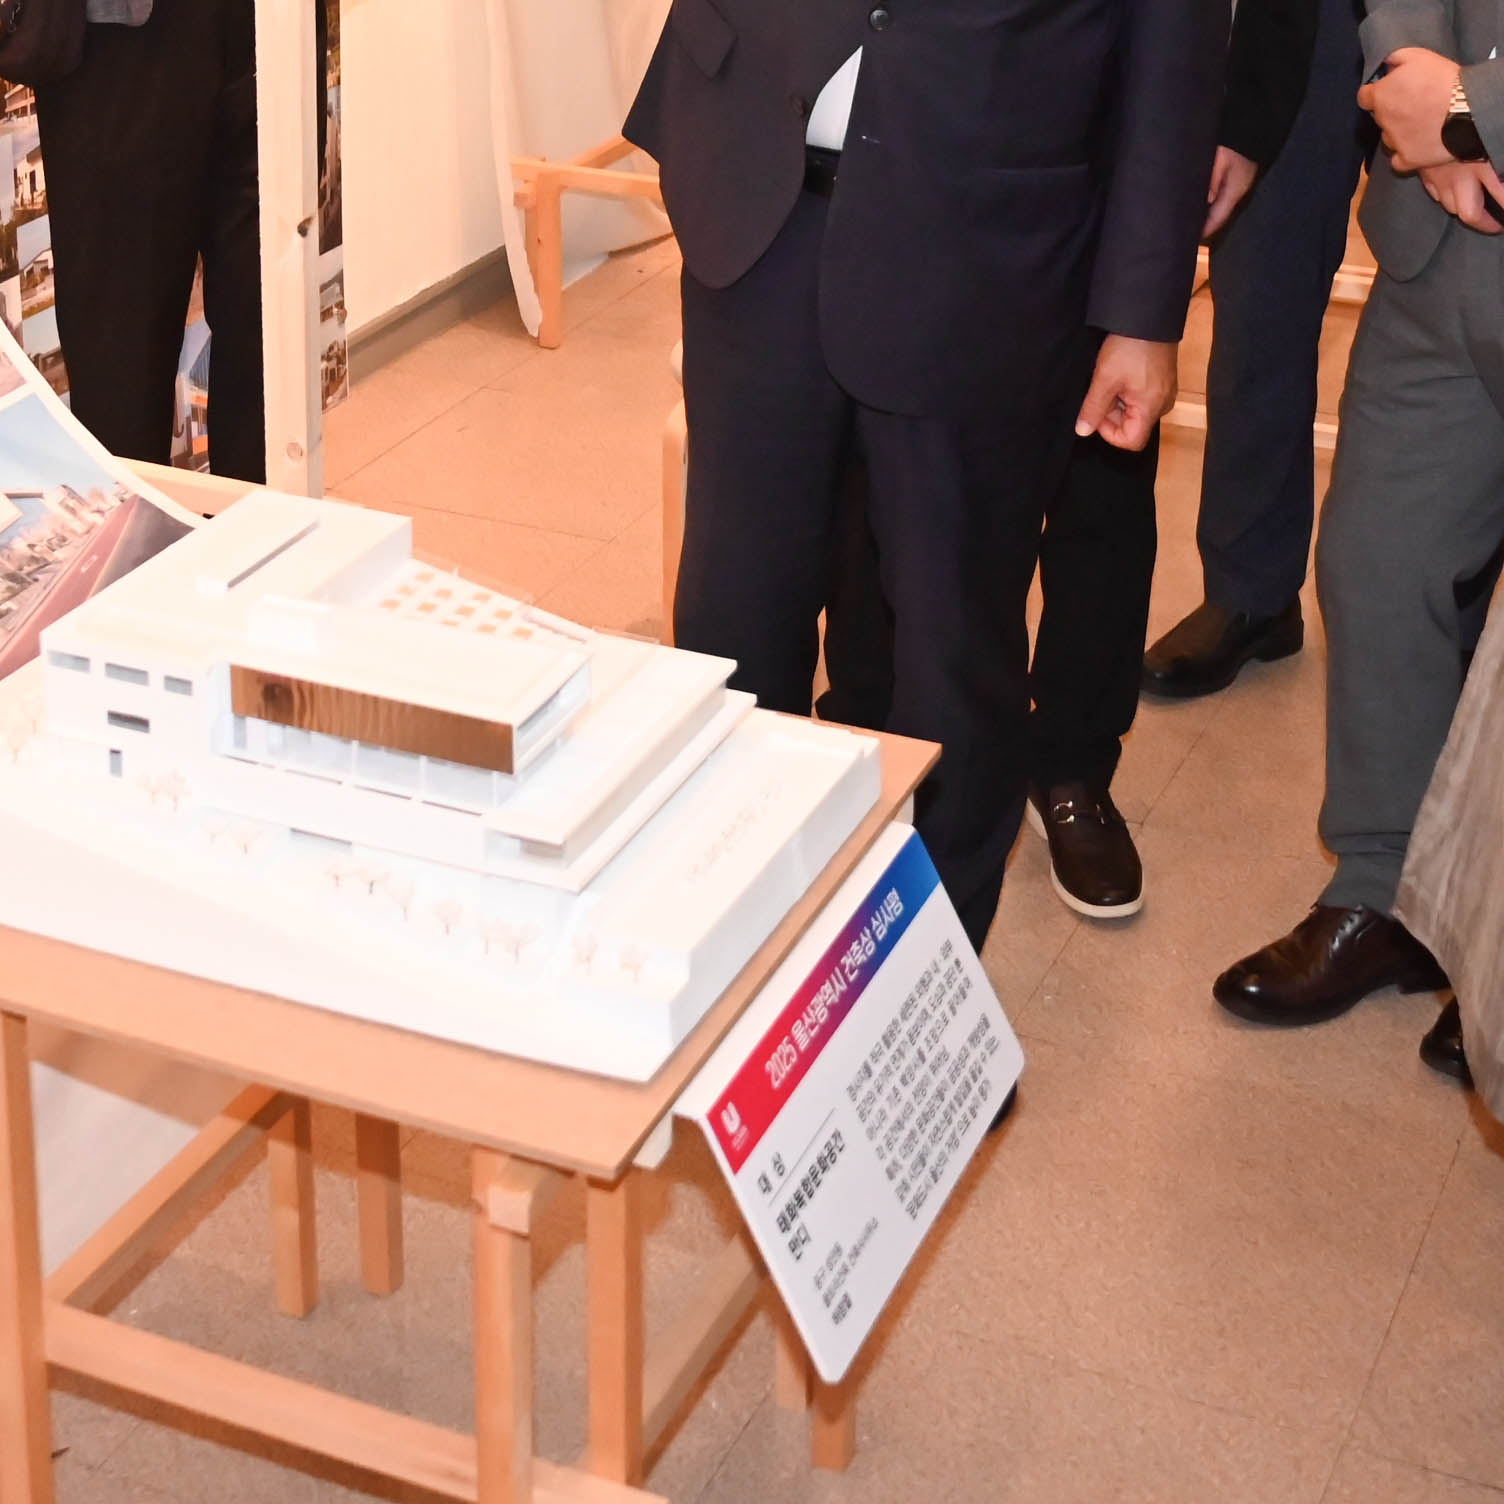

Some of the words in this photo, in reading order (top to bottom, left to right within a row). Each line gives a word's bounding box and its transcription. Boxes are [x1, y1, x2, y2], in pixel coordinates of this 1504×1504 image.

[763, 1033, 799, 1091] 2025
[789, 965, 848, 1054] 울산광역시
[839, 925, 876, 984] 건축상
[868, 885, 904, 942] 심사평
[775, 1126, 846, 1238] 태화복합문화공간
[787, 1221, 812, 1264] 만디
